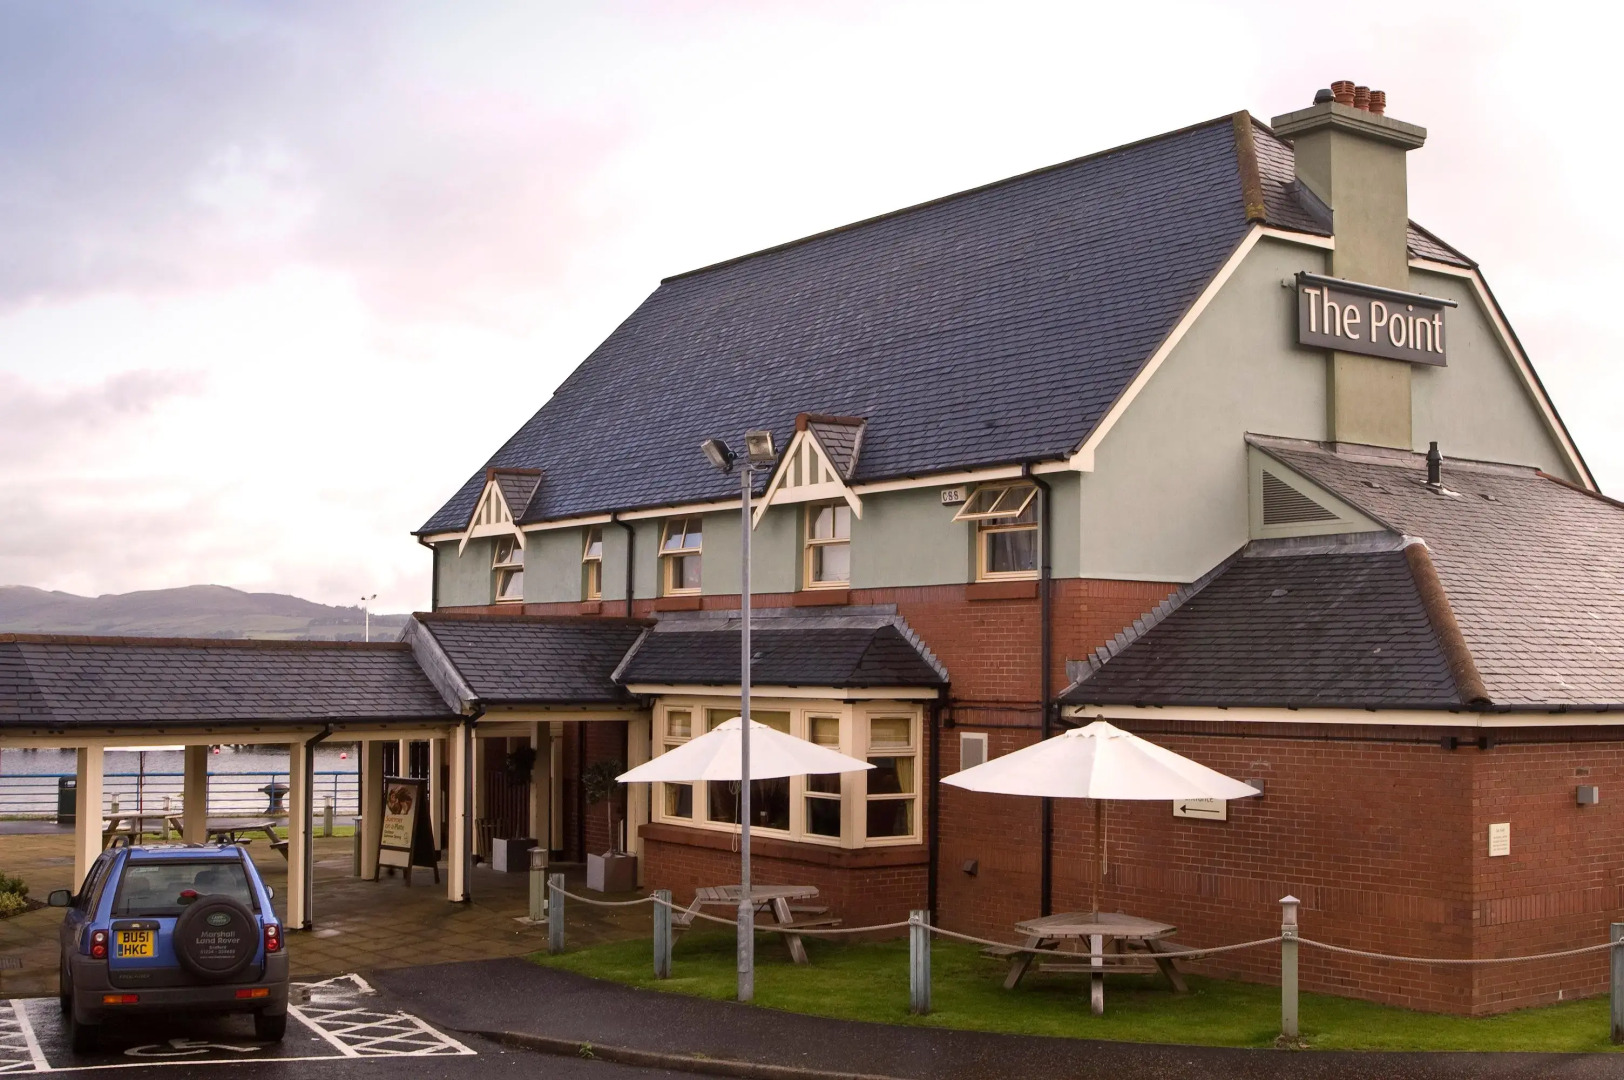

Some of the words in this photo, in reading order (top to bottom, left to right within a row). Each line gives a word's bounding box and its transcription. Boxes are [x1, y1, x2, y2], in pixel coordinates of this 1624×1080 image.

[1303, 286, 1341, 340] The
[1369, 300, 1444, 354] Point
[123, 931, 149, 943] BU51
[195, 937, 216, 945] Land
[217, 937, 241, 945] Rover
[124, 943, 148, 955] HKC
